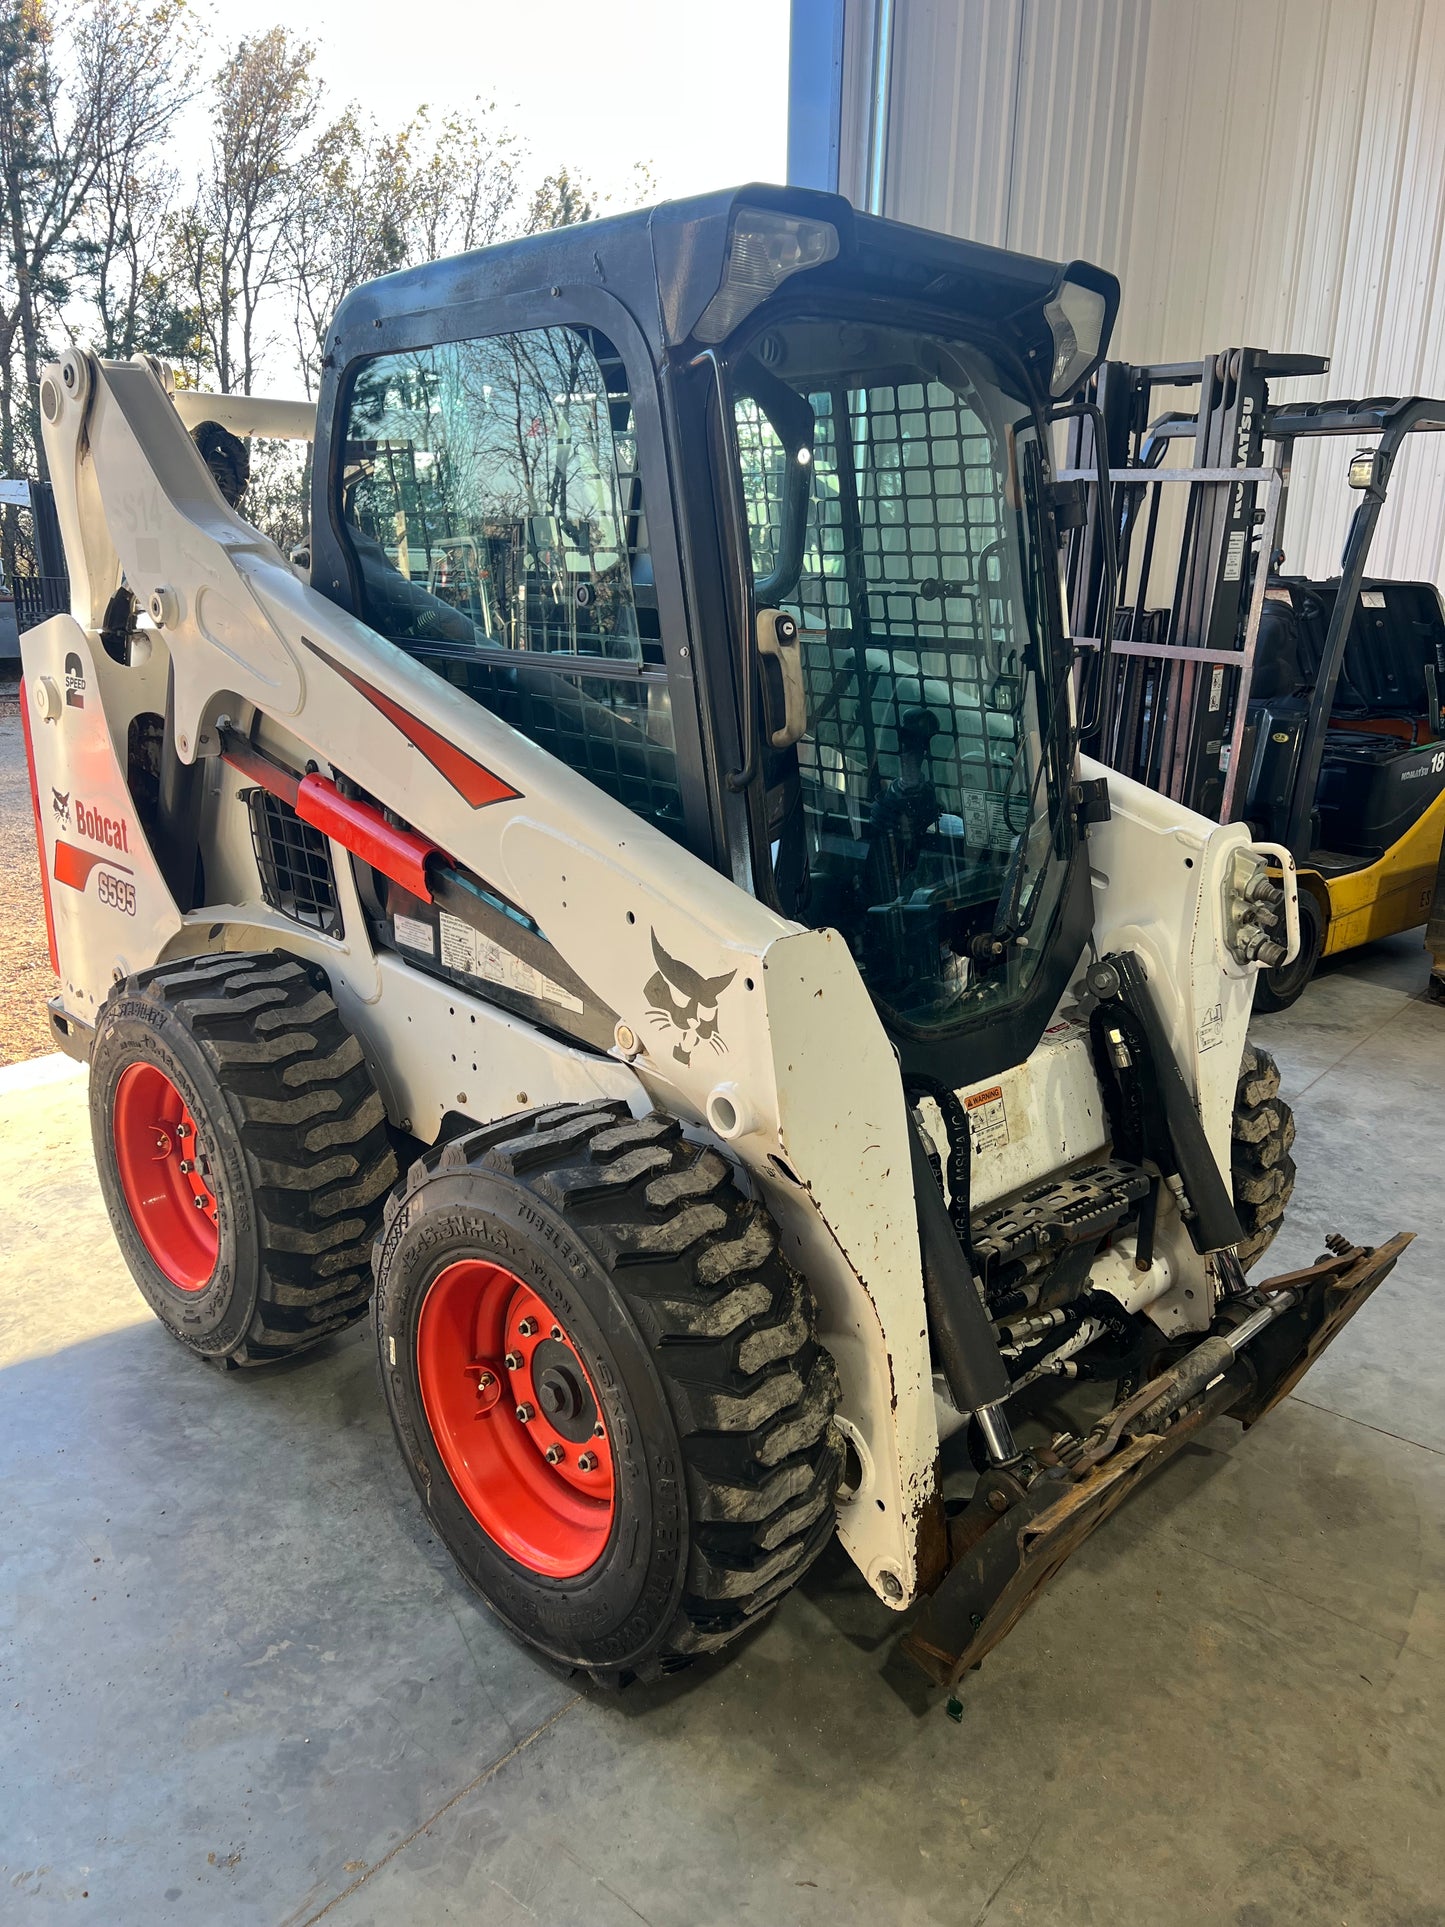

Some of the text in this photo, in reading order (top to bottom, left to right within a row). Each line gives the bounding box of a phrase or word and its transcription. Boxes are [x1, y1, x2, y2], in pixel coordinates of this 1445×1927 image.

[65, 676, 86, 691] SPEED
[75, 800, 129, 854] Bobcat
[98, 871, 136, 917] S595
[972, 1088, 1000, 1105] WARNING
[516, 1201, 589, 1280] TUBELESS
